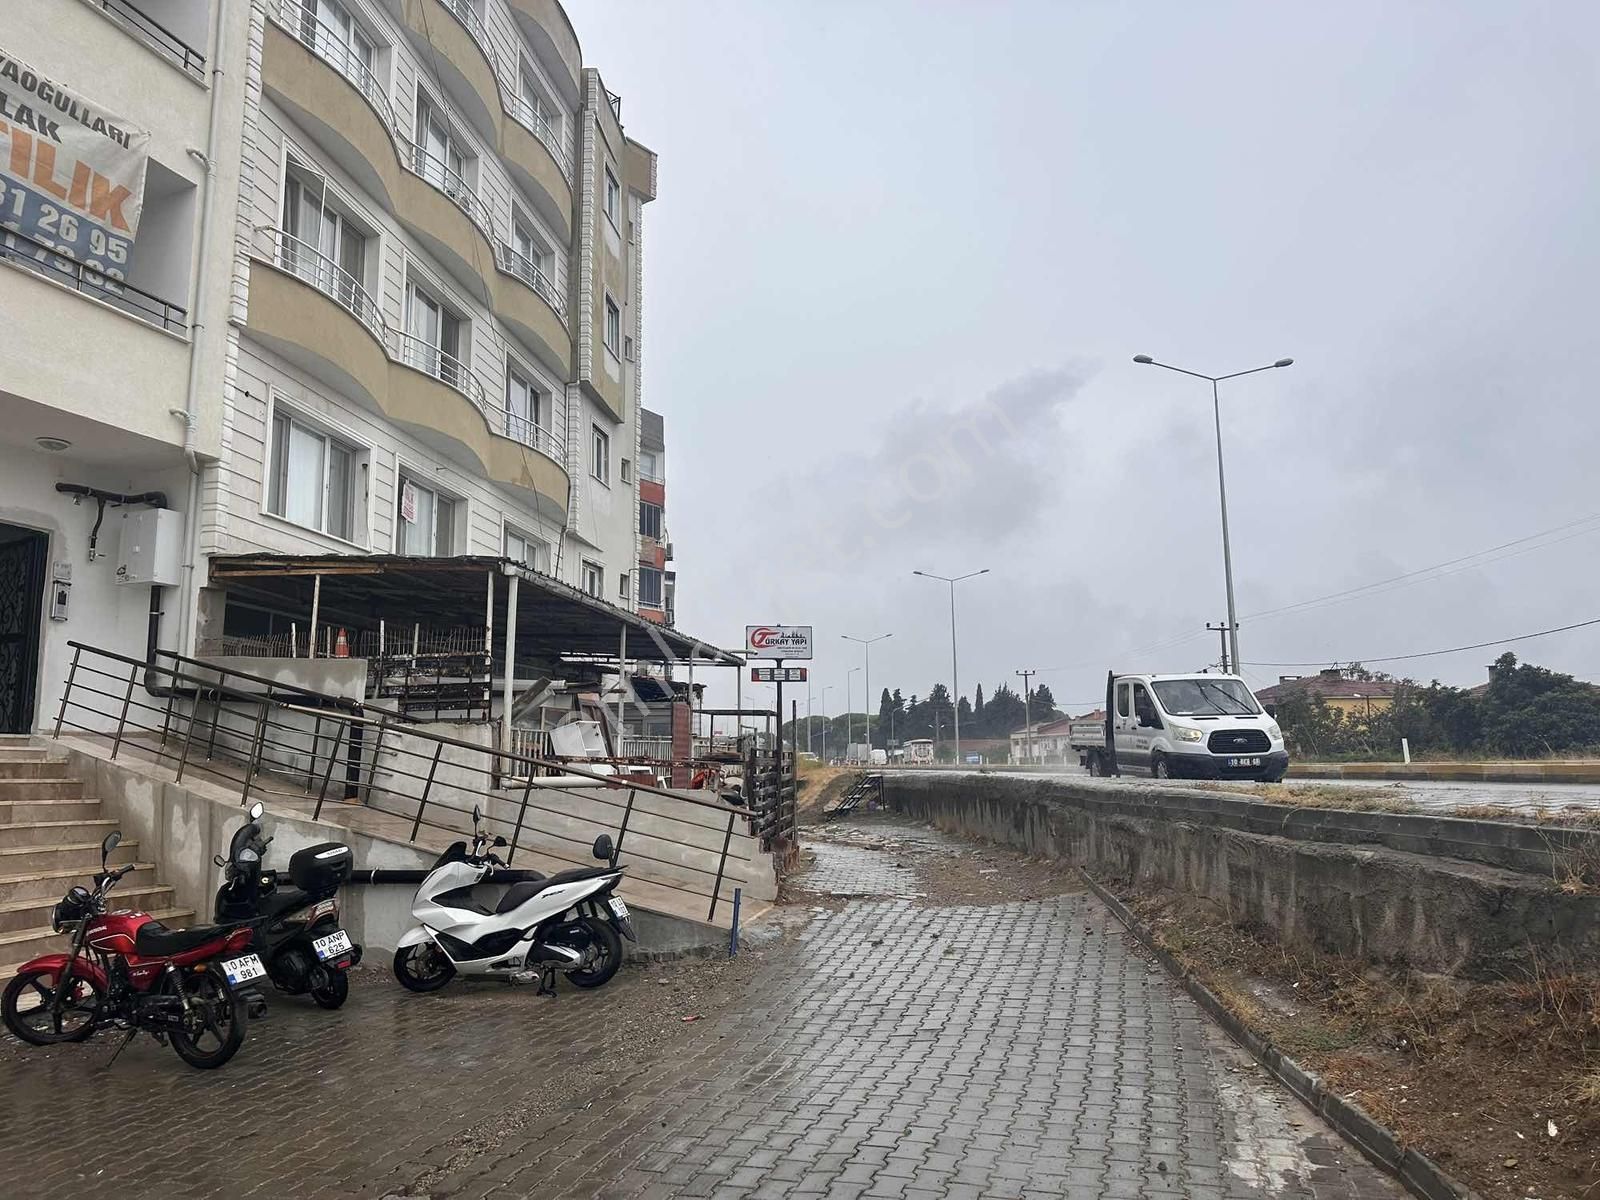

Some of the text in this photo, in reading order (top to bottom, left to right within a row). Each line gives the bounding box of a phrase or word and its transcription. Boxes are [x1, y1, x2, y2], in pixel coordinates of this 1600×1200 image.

[0, 55, 130, 149] AOĞULLARI
[0, 119, 131, 232] ILIK
[38, 203, 79, 242] 26
[89, 229, 128, 264] 95
[791, 638, 807, 646] YAPI
[314, 931, 344, 948] 10 ANP
[328, 942, 345, 954] 625
[239, 955, 259, 968] AFM
[240, 967, 258, 979] 981
